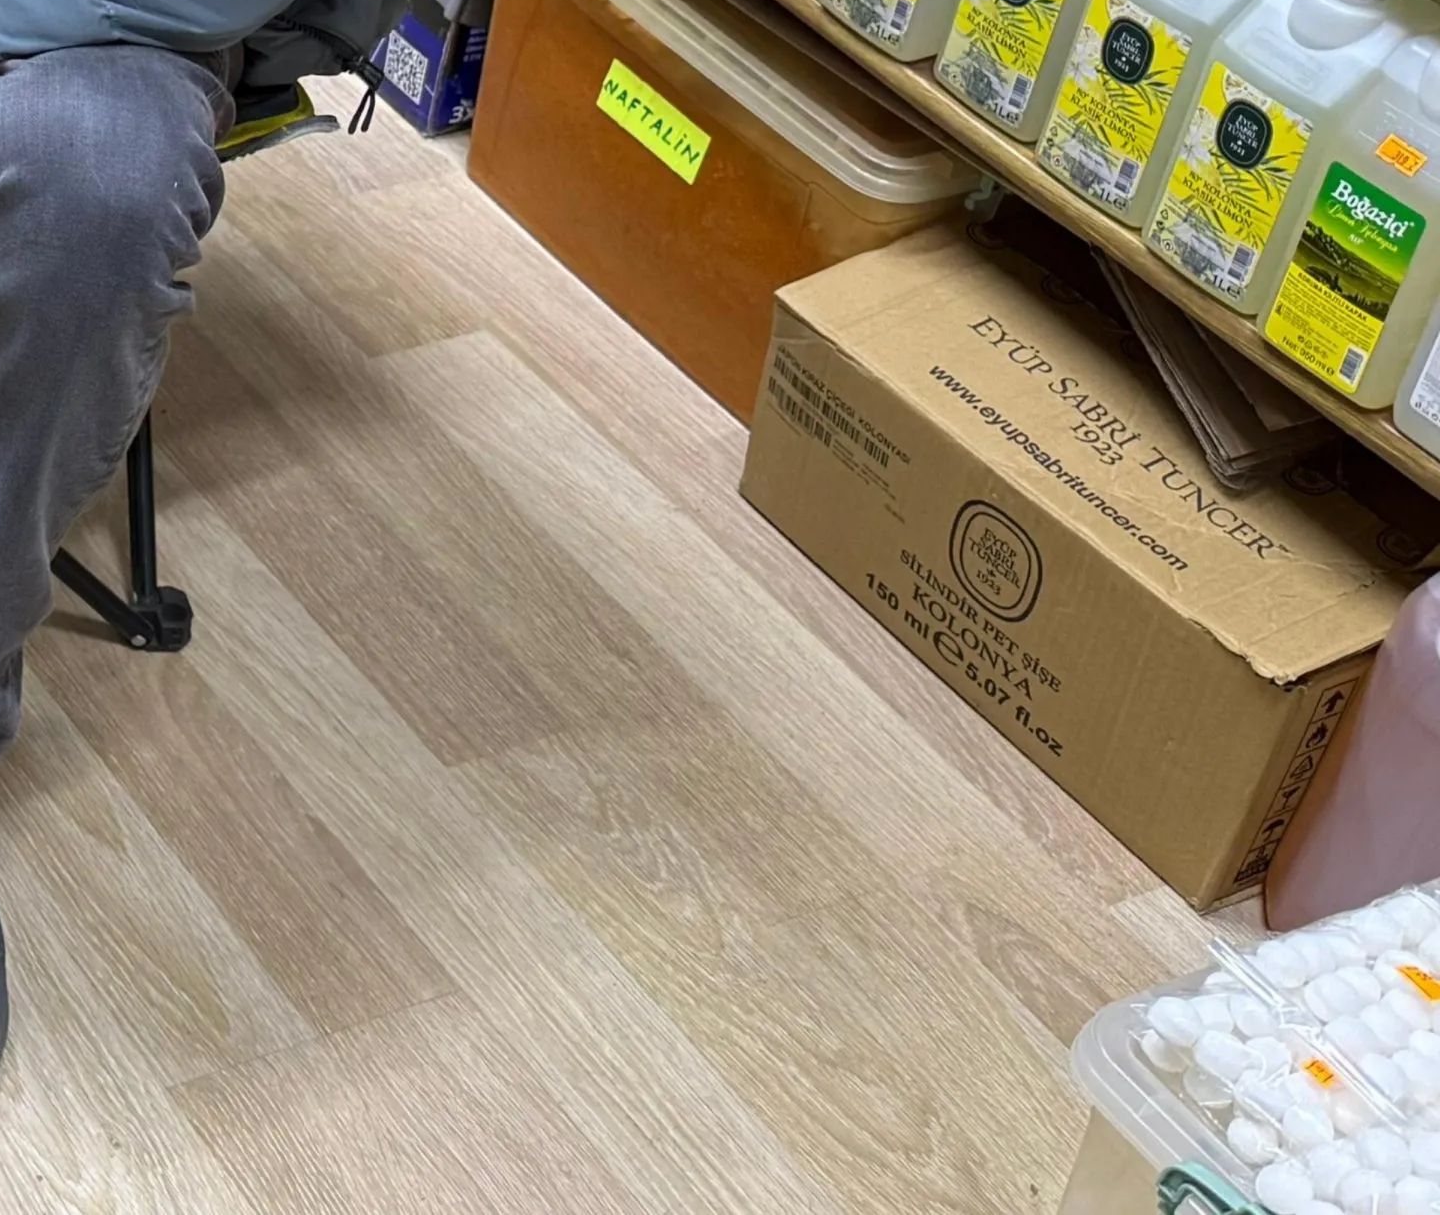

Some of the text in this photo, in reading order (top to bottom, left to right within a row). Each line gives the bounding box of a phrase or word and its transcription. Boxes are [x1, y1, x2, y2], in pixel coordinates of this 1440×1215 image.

[603, 78, 701, 166] NAFTALİN
[1089, 93, 1136, 132] KOLONYA
[1203, 176, 1252, 219] KOLONYA
[1331, 179, 1409, 238] Boğaziçi
[858, 417, 911, 465] KOLONYASI
[968, 314, 1272, 560] EYÜP SABRİ TUNCER
[1070, 421, 1124, 468] 1923
[928, 362, 1189, 575] www.eyupsabrituncer.com
[969, 537, 1021, 589] TUNCER
[976, 569, 1001, 596] 1923
[900, 548, 1062, 693] SİLİNDİR PET ŞİŞE
[912, 582, 1033, 700] KOLONYA
[866, 573, 899, 611] 150
[904, 609, 930, 640] ml
[965, 661, 1011, 706] 5.07
[1014, 704, 1064, 757] fl.oz
